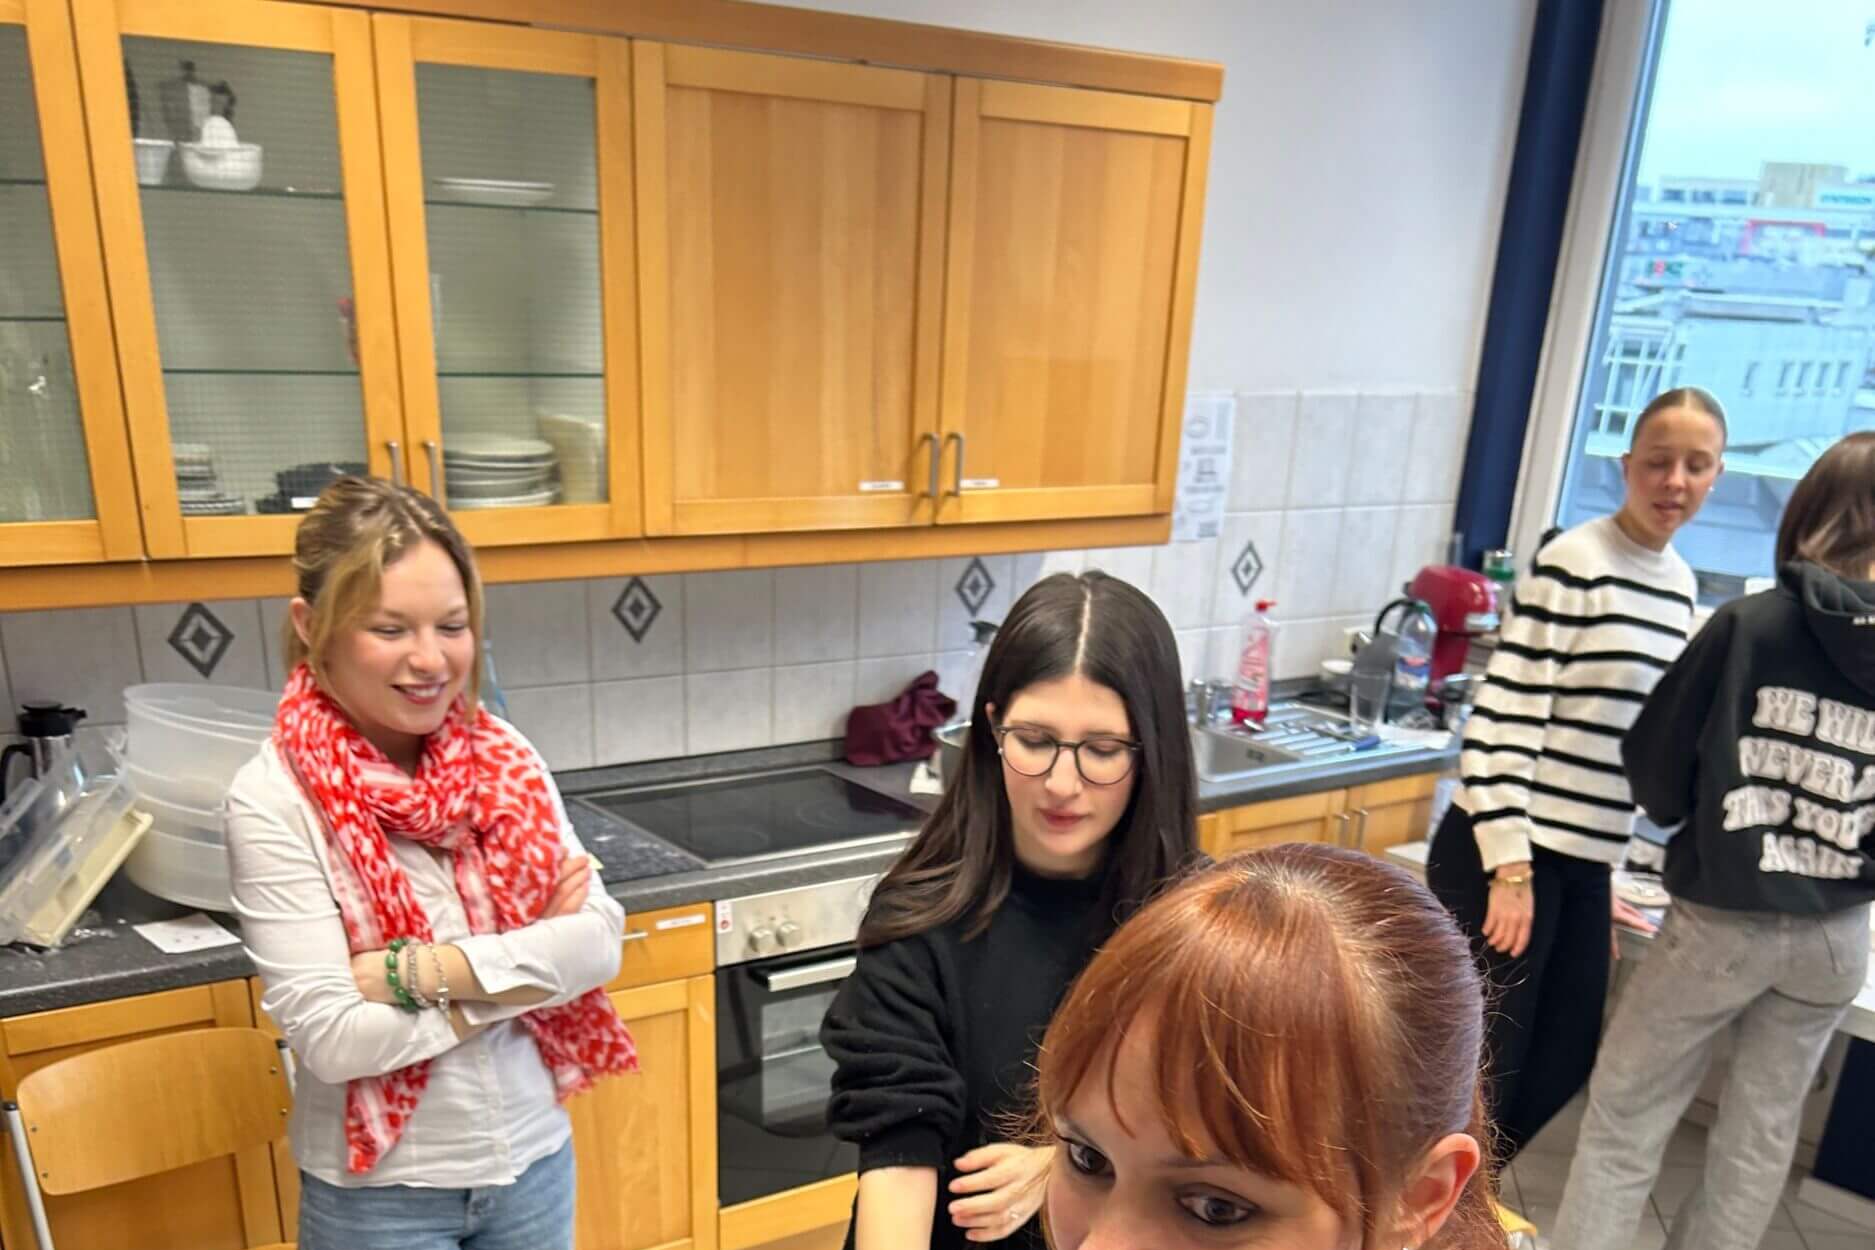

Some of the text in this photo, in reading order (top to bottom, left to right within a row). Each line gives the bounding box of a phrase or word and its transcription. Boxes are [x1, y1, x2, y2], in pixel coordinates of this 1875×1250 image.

[1752, 686, 1816, 737] WE
[1738, 736, 1856, 804] NEVER
[1758, 831, 1865, 880] AGAIN
